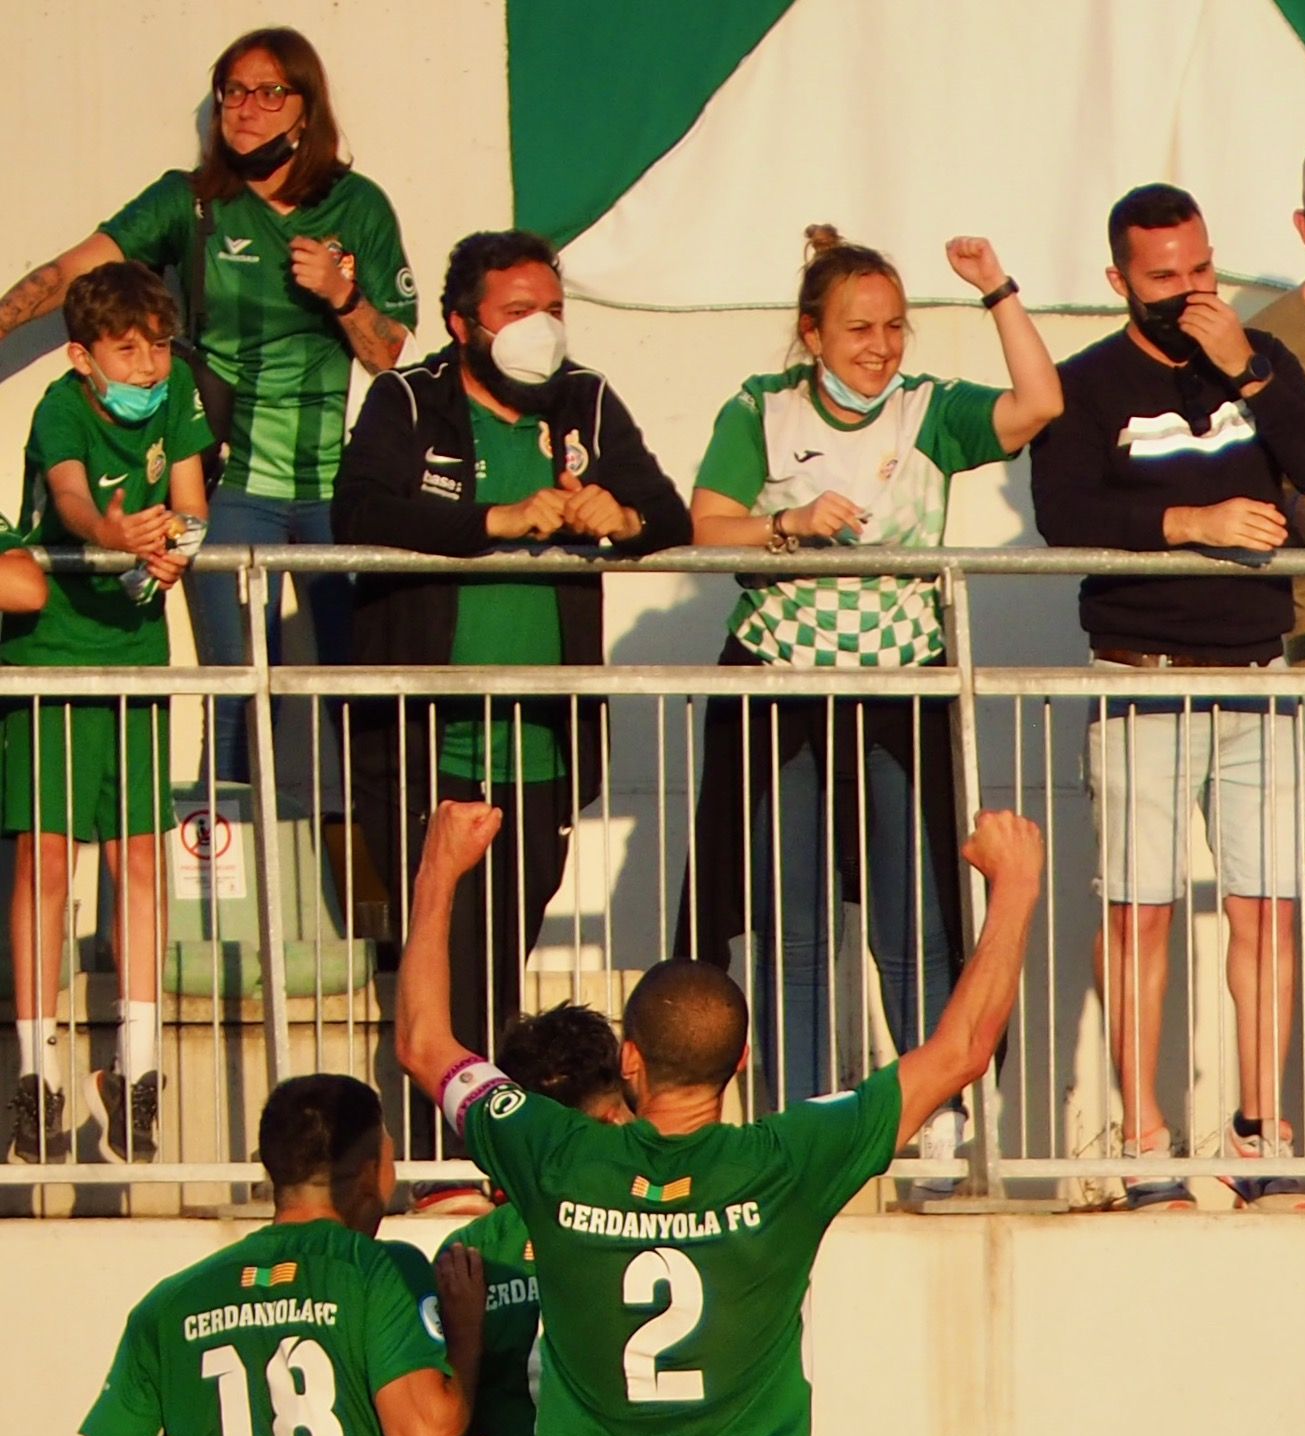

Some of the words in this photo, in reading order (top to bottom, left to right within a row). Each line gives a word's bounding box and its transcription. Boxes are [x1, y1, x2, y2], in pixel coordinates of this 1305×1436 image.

[558, 1201, 721, 1239] CERDANYOLA
[725, 1201, 761, 1231] FC
[184, 1298, 315, 1341] CERDANYOLA
[622, 1247, 705, 1402] 2
